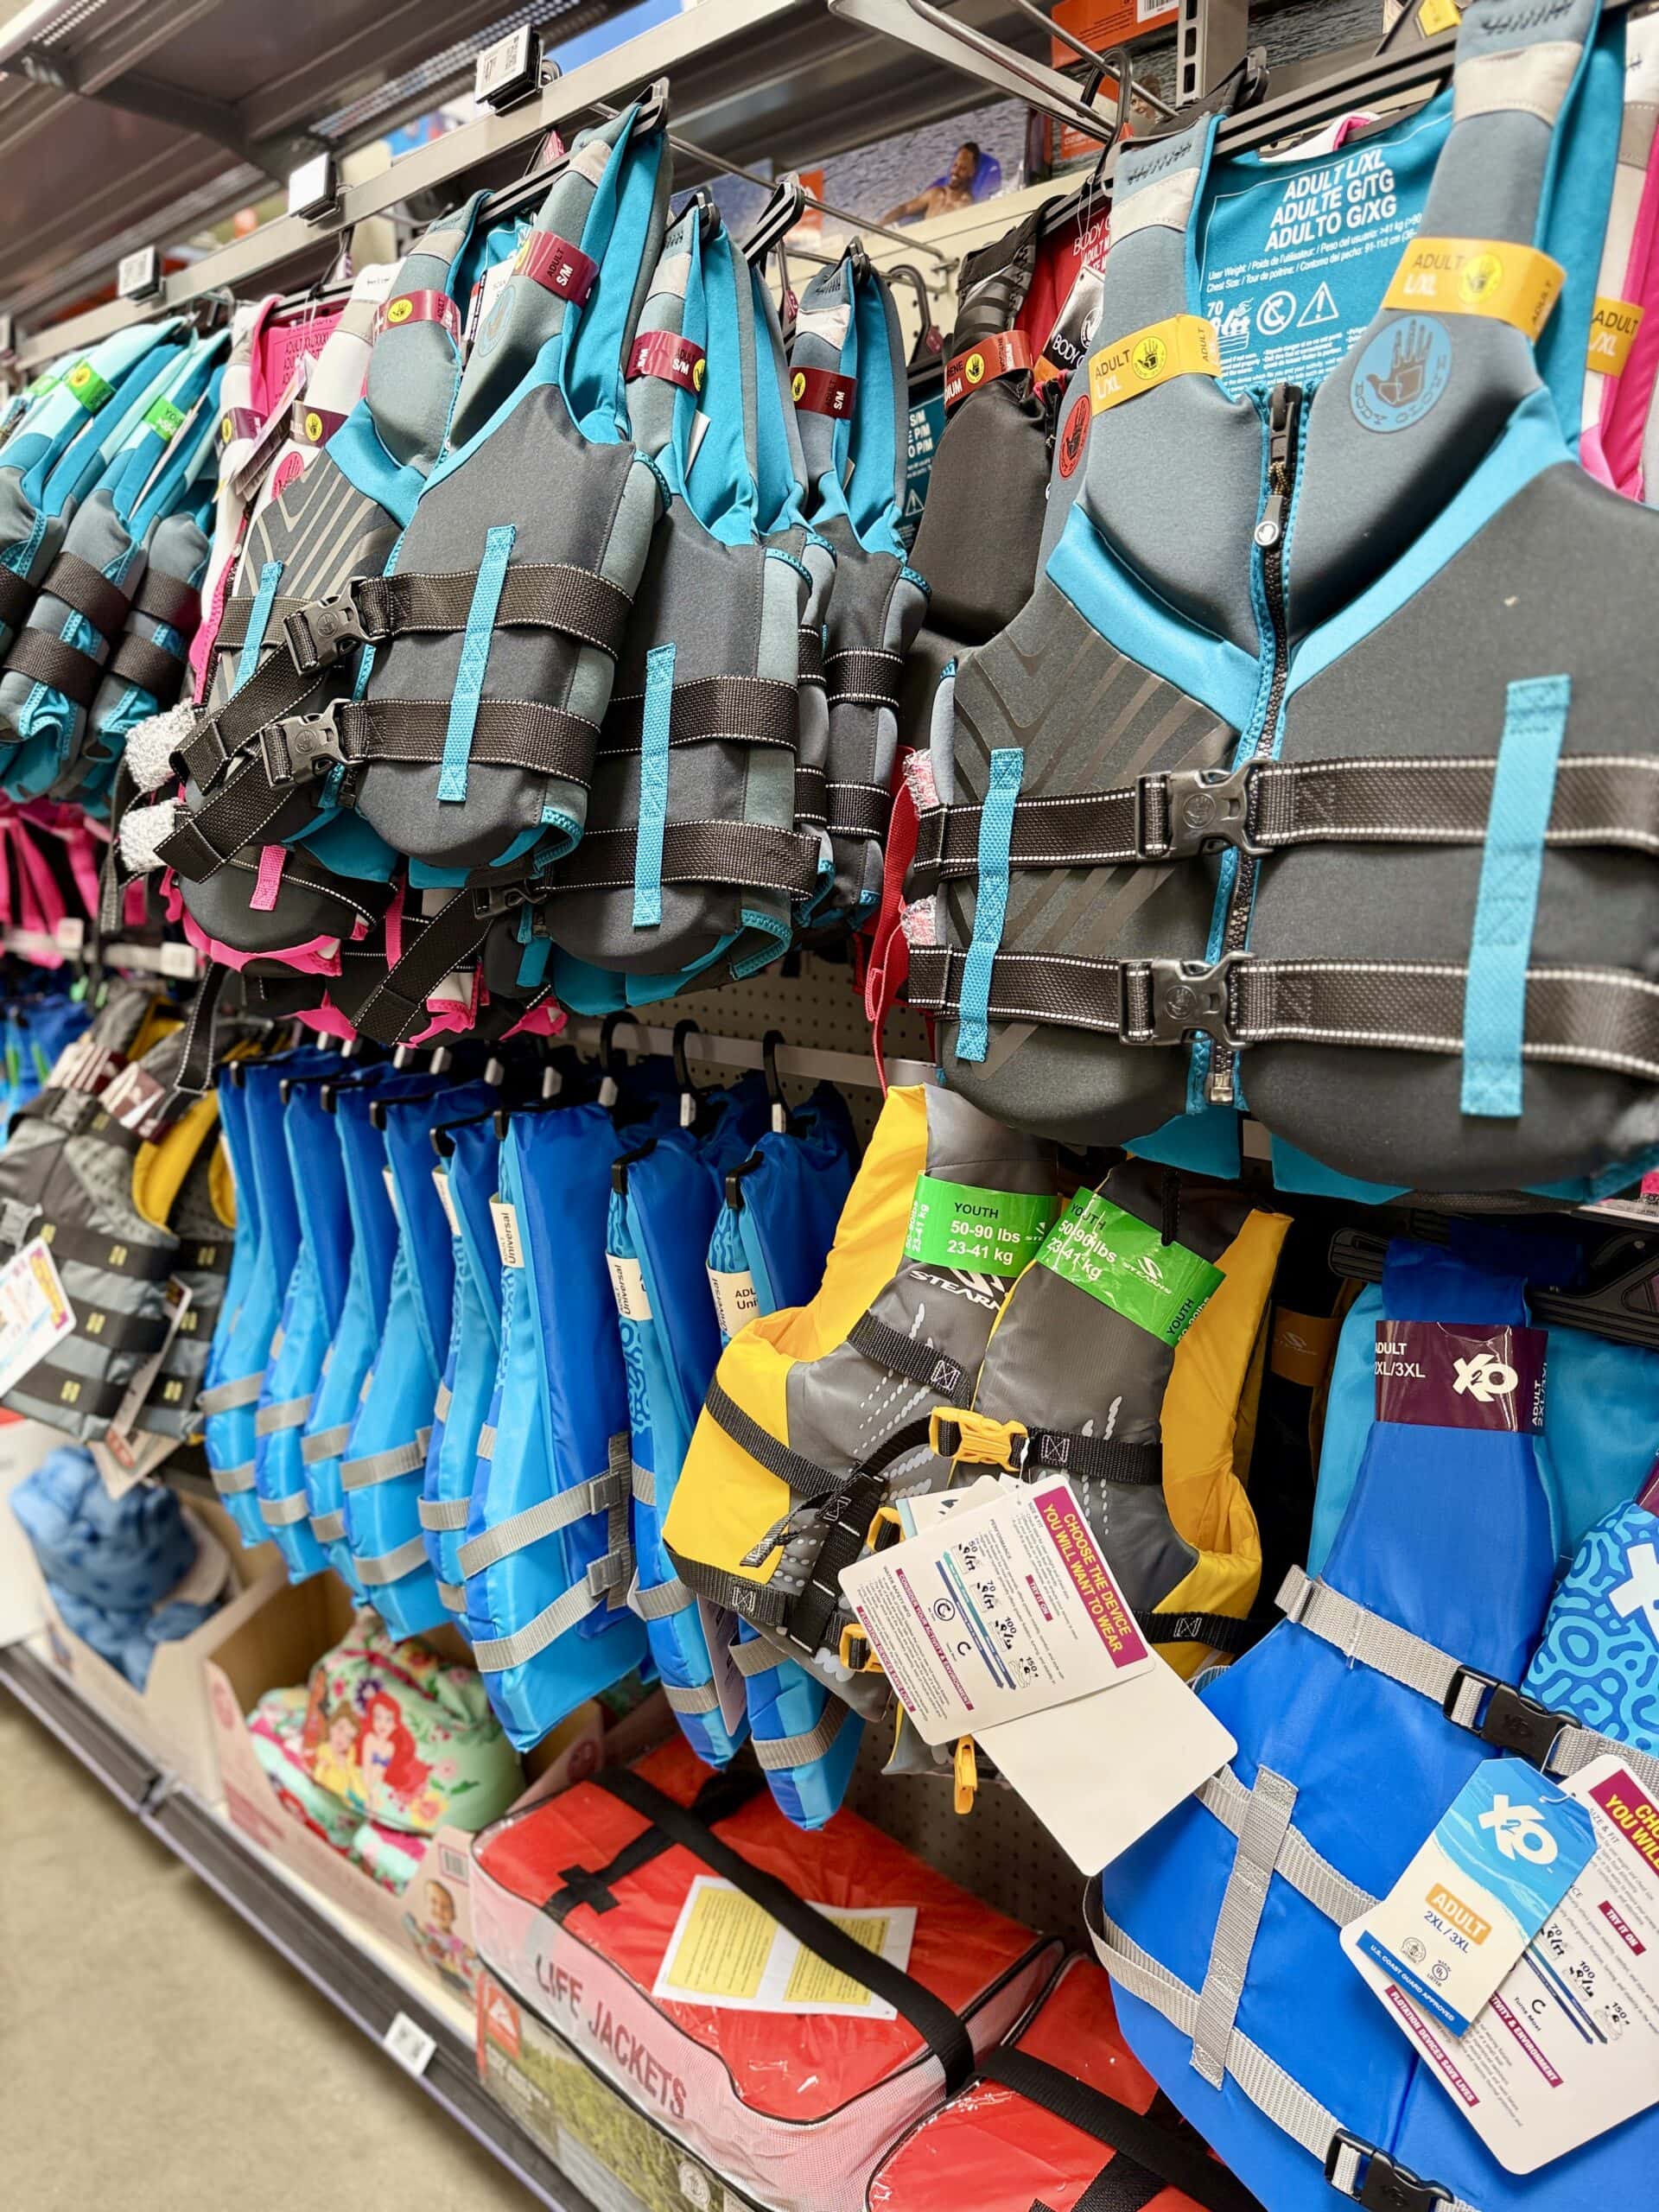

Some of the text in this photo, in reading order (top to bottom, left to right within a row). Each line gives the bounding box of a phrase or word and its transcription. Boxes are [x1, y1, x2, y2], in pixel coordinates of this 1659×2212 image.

[1283, 149, 1386, 202] ADULT L/XL
[1270, 169, 1395, 228] ADULTE G/TG
[1264, 195, 1397, 252] ADULTO G/XG
[1072, 219, 1105, 257] BODY
[1320, 241, 1338, 252] Peso
[547, 247, 565, 277] ADULT
[1412, 252, 1465, 270] ADULT
[556, 263, 574, 287] S/M
[1402, 274, 1438, 295] L/XL
[1207, 300, 1224, 317] 70
[1592, 309, 1640, 337] ADULT
[1052, 334, 1078, 366] BODY
[1589, 332, 1618, 356] /XL
[672, 358, 690, 375] S/M
[1095, 349, 1131, 381] ADULT
[833, 391, 846, 410] S/M
[1096, 375, 1122, 401] L/XL
[909, 409, 927, 428] S/M
[914, 422, 931, 441] P/M
[916, 436, 934, 455] P/M
[918, 1204, 930, 1219] kg
[954, 1202, 999, 1219] YOUTH
[1071, 1203, 1107, 1230] YOUTH
[500, 1212, 517, 1264] Universal
[950, 1220, 1021, 1243] 50-90 lbs
[947, 1240, 1014, 1266] 23-41 kg
[1091, 1238, 1118, 1264] lbs
[1081, 1261, 1103, 1281] kg
[1122, 1261, 1173, 1295] STEARNS
[614, 1264, 632, 1315] Universal
[909, 1270, 1001, 1311] STEARN
[736, 1298, 758, 1311] Uni
[1166, 1298, 1194, 1335] YOUTH
[1531, 1380, 1542, 1427] ADULT
[967, 1540, 978, 1554] 50
[986, 1580, 996, 1592] 70
[1041, 1503, 1123, 1653] YOU WILL WANT TO WEAR
[1060, 1512, 1132, 1637] CHOOSE THE DEVICE
[1039, 1602, 1049, 1615] ON
[1003, 1616, 1017, 1635] 100
[1025, 1656, 1037, 1673] 150
[1605, 1794, 1638, 1829] YOU
[1635, 1803, 1659, 1839] CHO
[1606, 1830, 1620, 1845] FIT
[1432, 1891, 1489, 1936] ADULT
[1423, 1910, 1445, 1934] 2XL
[1449, 1931, 1470, 1954] 3XL
[1549, 1923, 1563, 1937] 70
[1605, 1907, 1638, 1948] TRY IT ON
[1577, 1959, 1596, 1980] 100
[1370, 1944, 1382, 1959] U.S.
[1381, 1955, 1403, 1978] COAST
[1400, 1972, 1424, 1994] GUARD
[1421, 1991, 1455, 2023] APPROVED
[1513, 1996, 1529, 2015] Turns
[1611, 1999, 1627, 2020] 150
[535, 1953, 583, 2019] LIFE
[588, 2000, 687, 2120] JACKETS
[1389, 1990, 1421, 2031] FLOTATION
[1416, 2027, 1444, 2061] DEVICES
[1440, 2058, 1459, 2081] SAVE
[1453, 2077, 1475, 2103] LIVES
[1488, 1993, 1513, 2022] TIVITY
[1512, 2025, 1558, 2082] ENVIRONMENT
